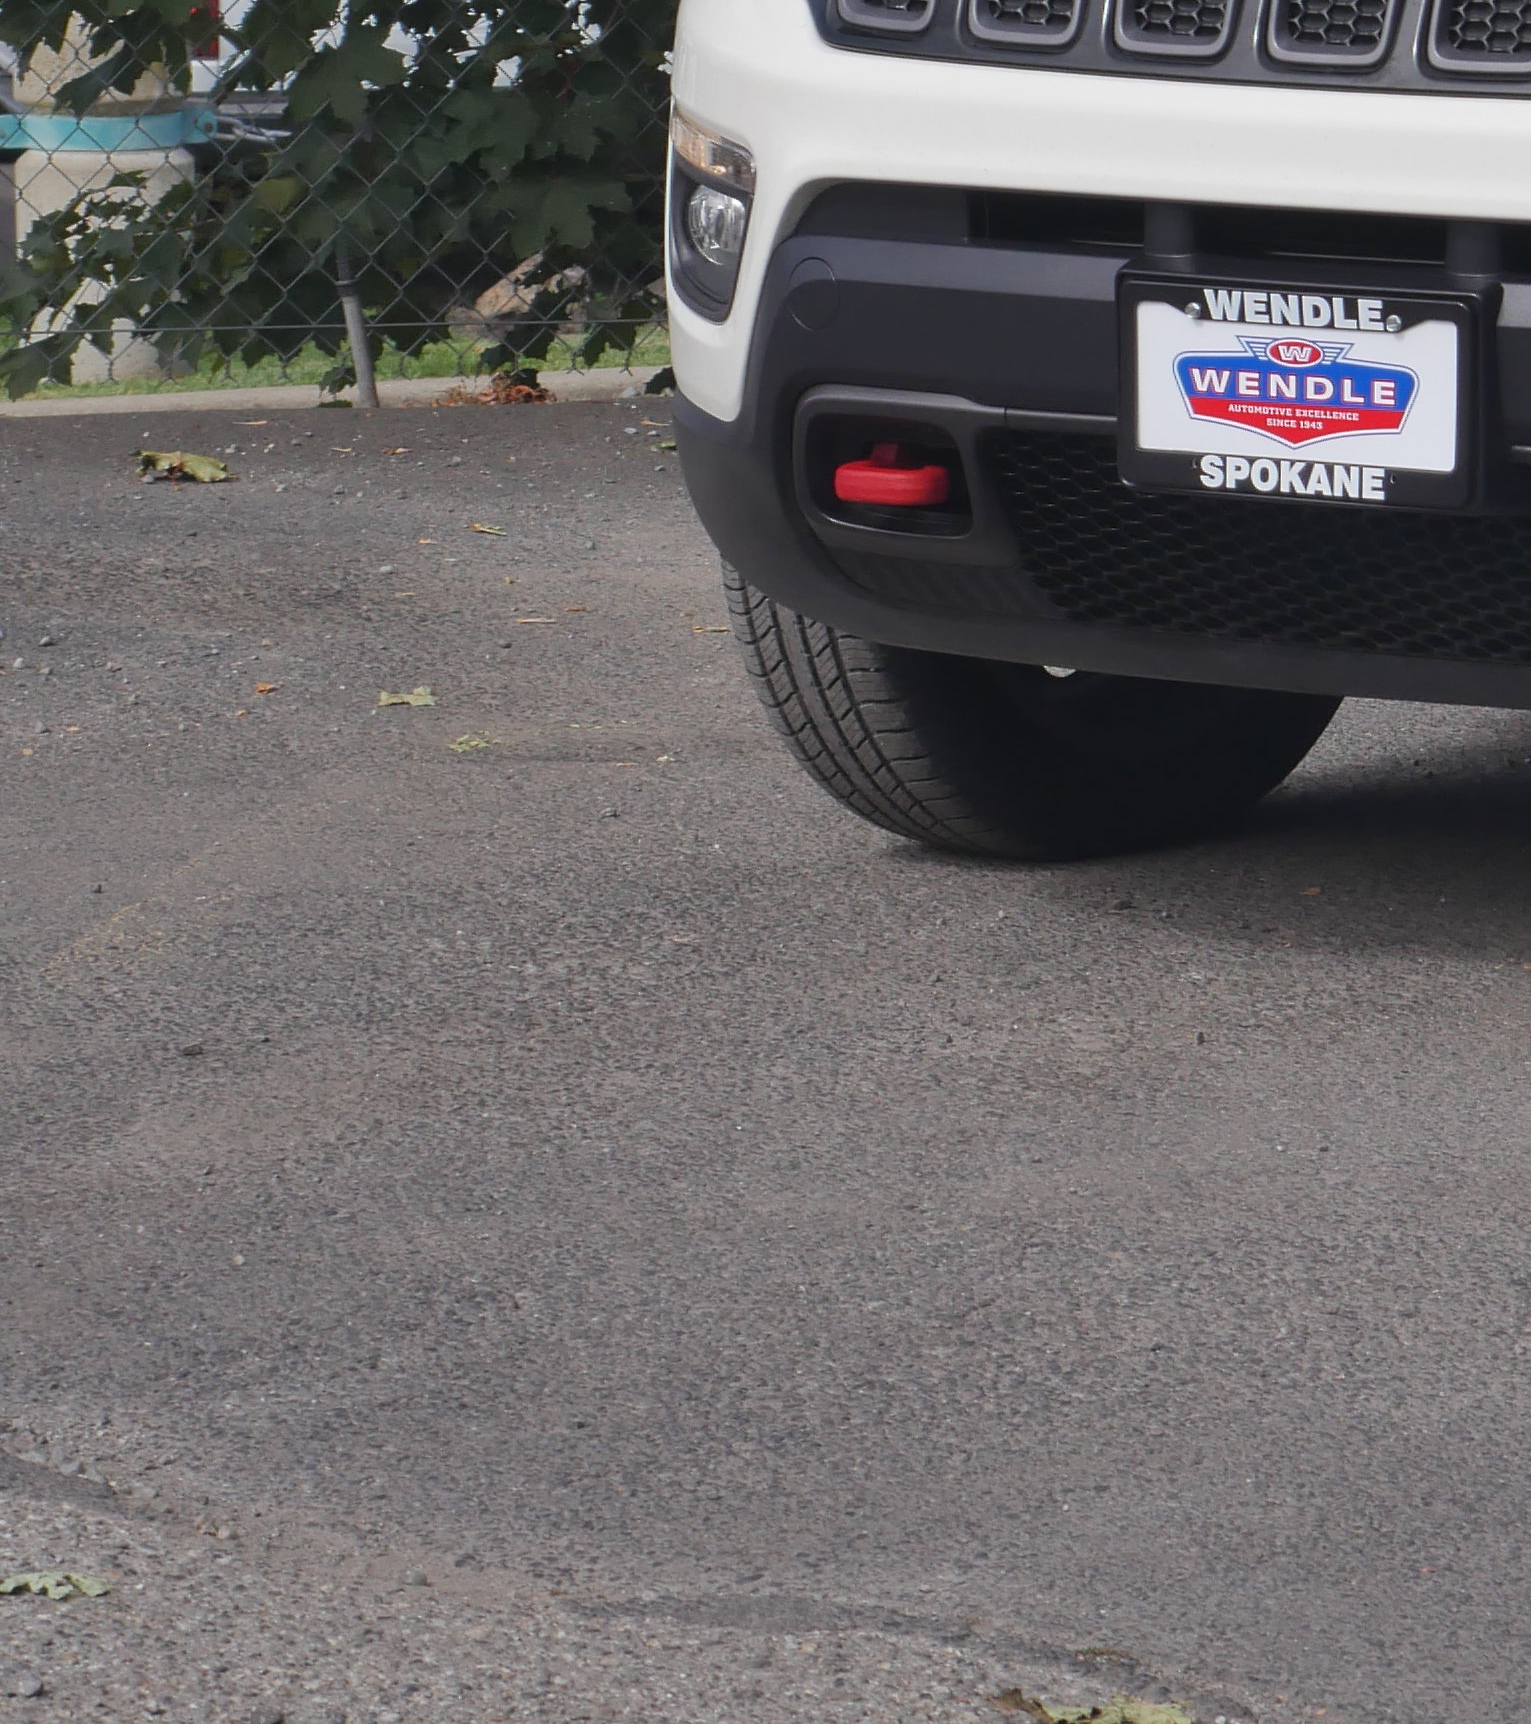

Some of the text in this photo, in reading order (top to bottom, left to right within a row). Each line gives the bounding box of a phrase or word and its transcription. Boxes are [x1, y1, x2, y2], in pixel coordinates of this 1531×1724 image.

[1203, 288, 1386, 332] WENDLE
[1189, 367, 1396, 406] WENDLE
[1228, 404, 1360, 421] AUTOMOTIVE EXCELLENCE
[1266, 418, 1324, 430] SINCE 1943
[1200, 454, 1386, 501] SPOKANE
